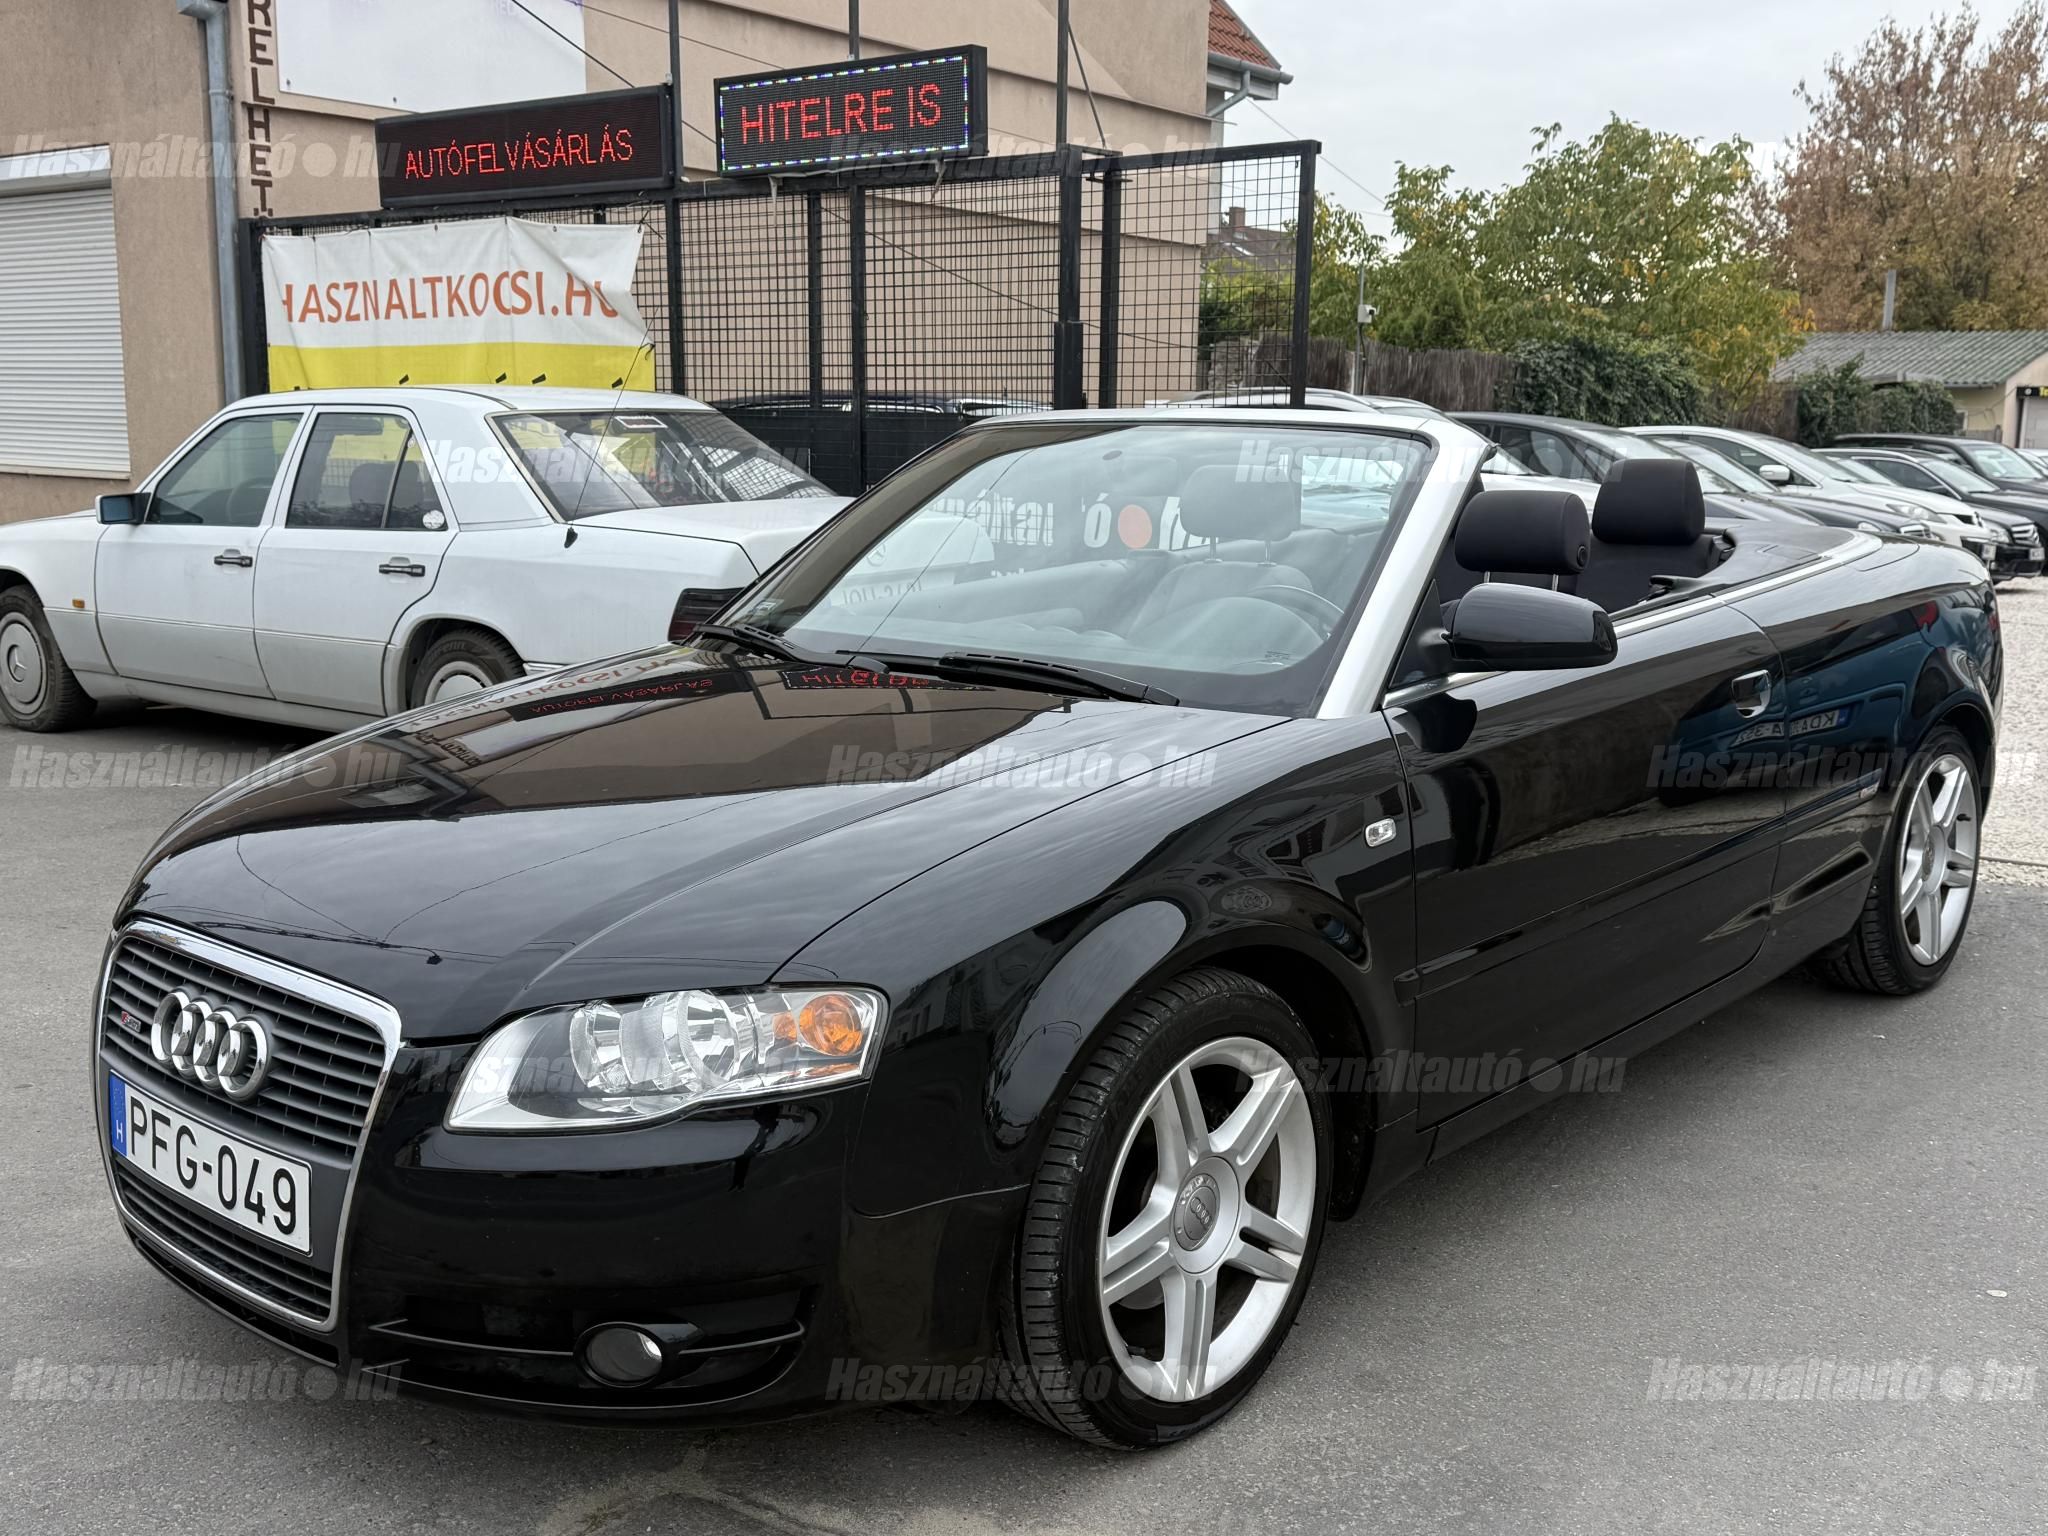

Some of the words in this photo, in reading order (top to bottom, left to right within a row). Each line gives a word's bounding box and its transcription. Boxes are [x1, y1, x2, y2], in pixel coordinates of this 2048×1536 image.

[741, 88, 894, 144] HITELRE
[908, 83, 942, 128] IS
[130, 1095, 296, 1235] PFG-049
